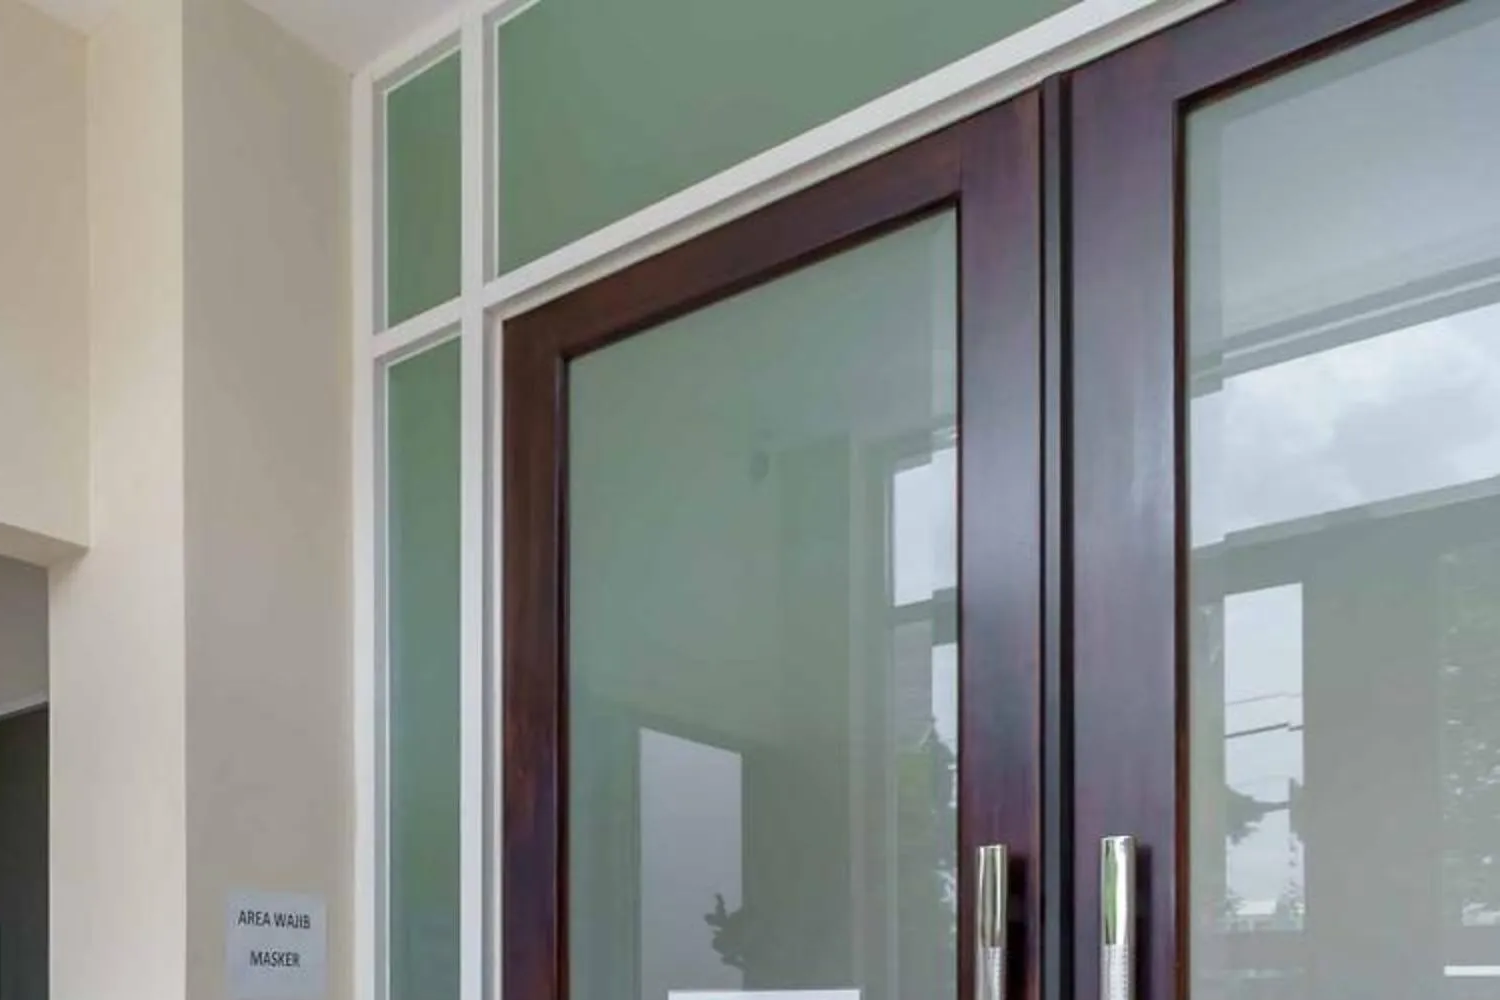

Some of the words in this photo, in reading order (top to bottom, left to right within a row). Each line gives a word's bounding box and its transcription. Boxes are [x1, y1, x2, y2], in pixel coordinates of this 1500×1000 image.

[238, 910, 271, 927] AREA
[274, 912, 311, 930] WAJIB
[249, 950, 301, 968] MASKER
